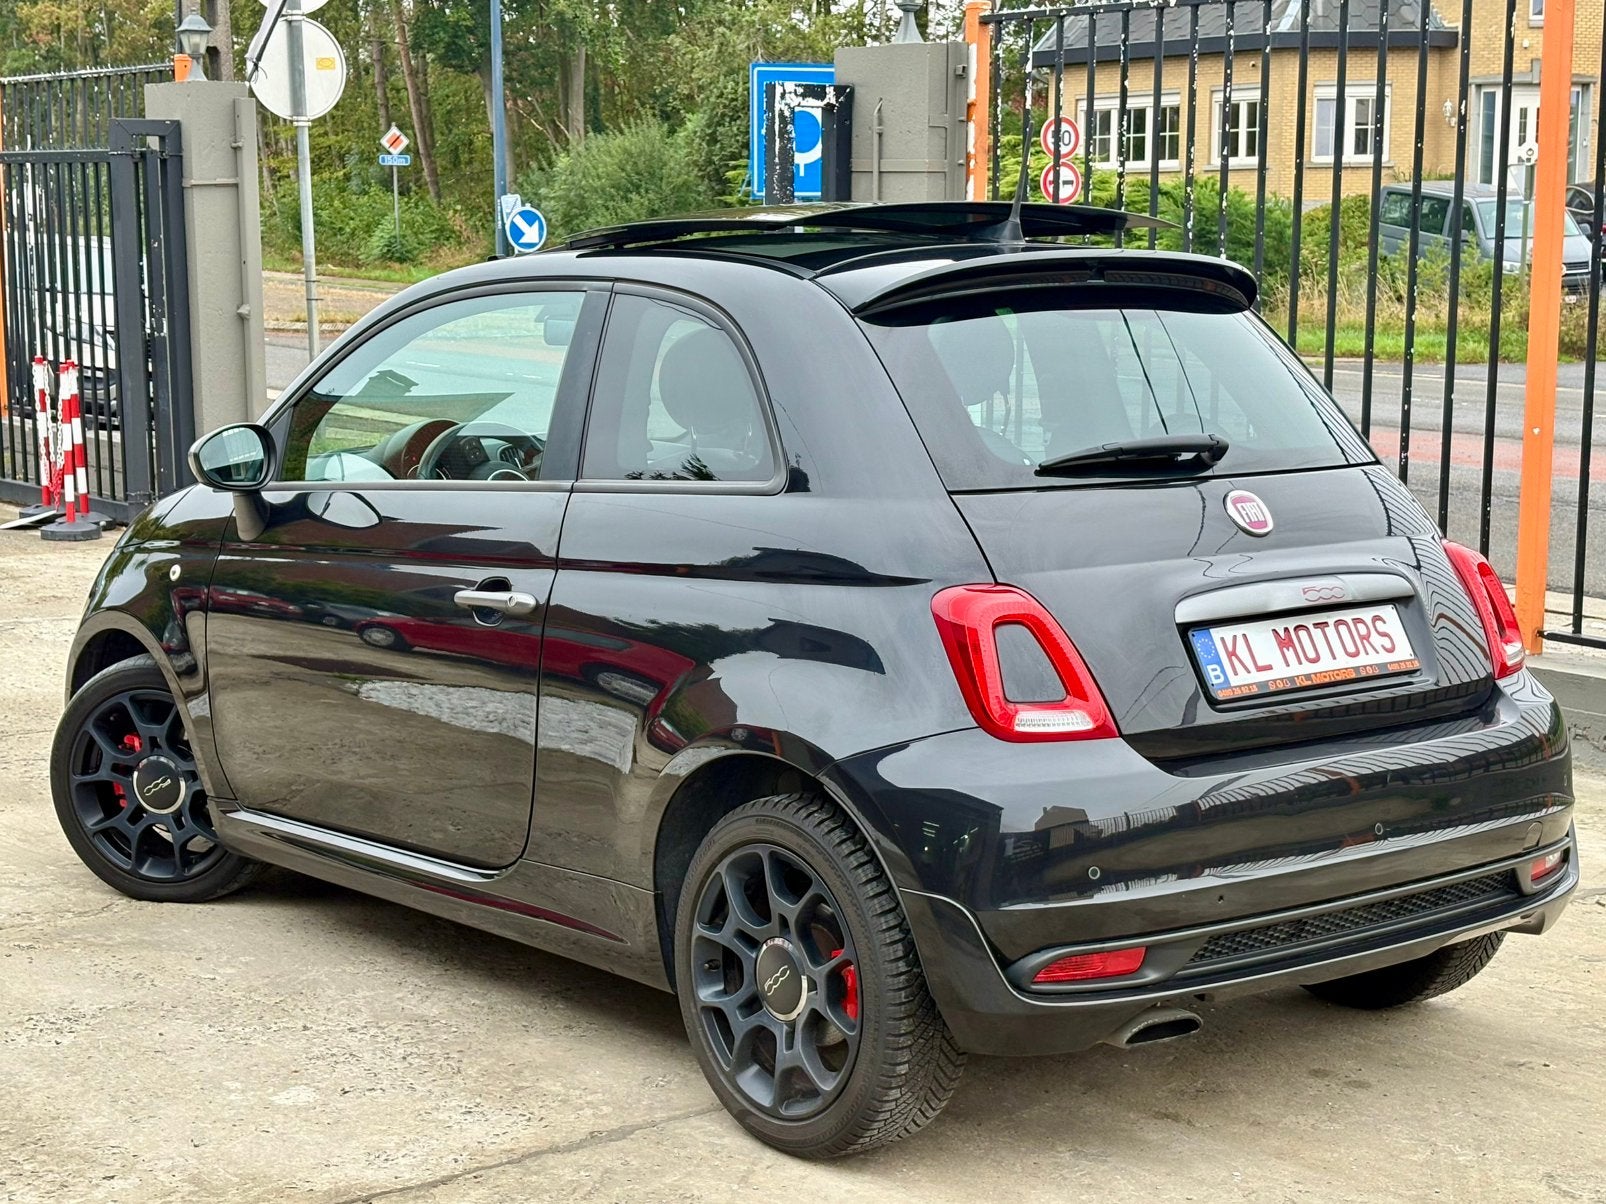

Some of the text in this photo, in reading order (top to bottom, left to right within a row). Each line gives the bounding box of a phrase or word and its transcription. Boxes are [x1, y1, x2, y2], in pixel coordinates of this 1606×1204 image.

[1235, 502, 1266, 523] FIAT
[1302, 586, 1345, 602] 500
[1219, 614, 1396, 676] KL MOTORS
[1206, 663, 1225, 684] B
[1294, 668, 1356, 686] KL MOTORS
[143, 775, 171, 796] 500
[764, 965, 790, 996] 500
